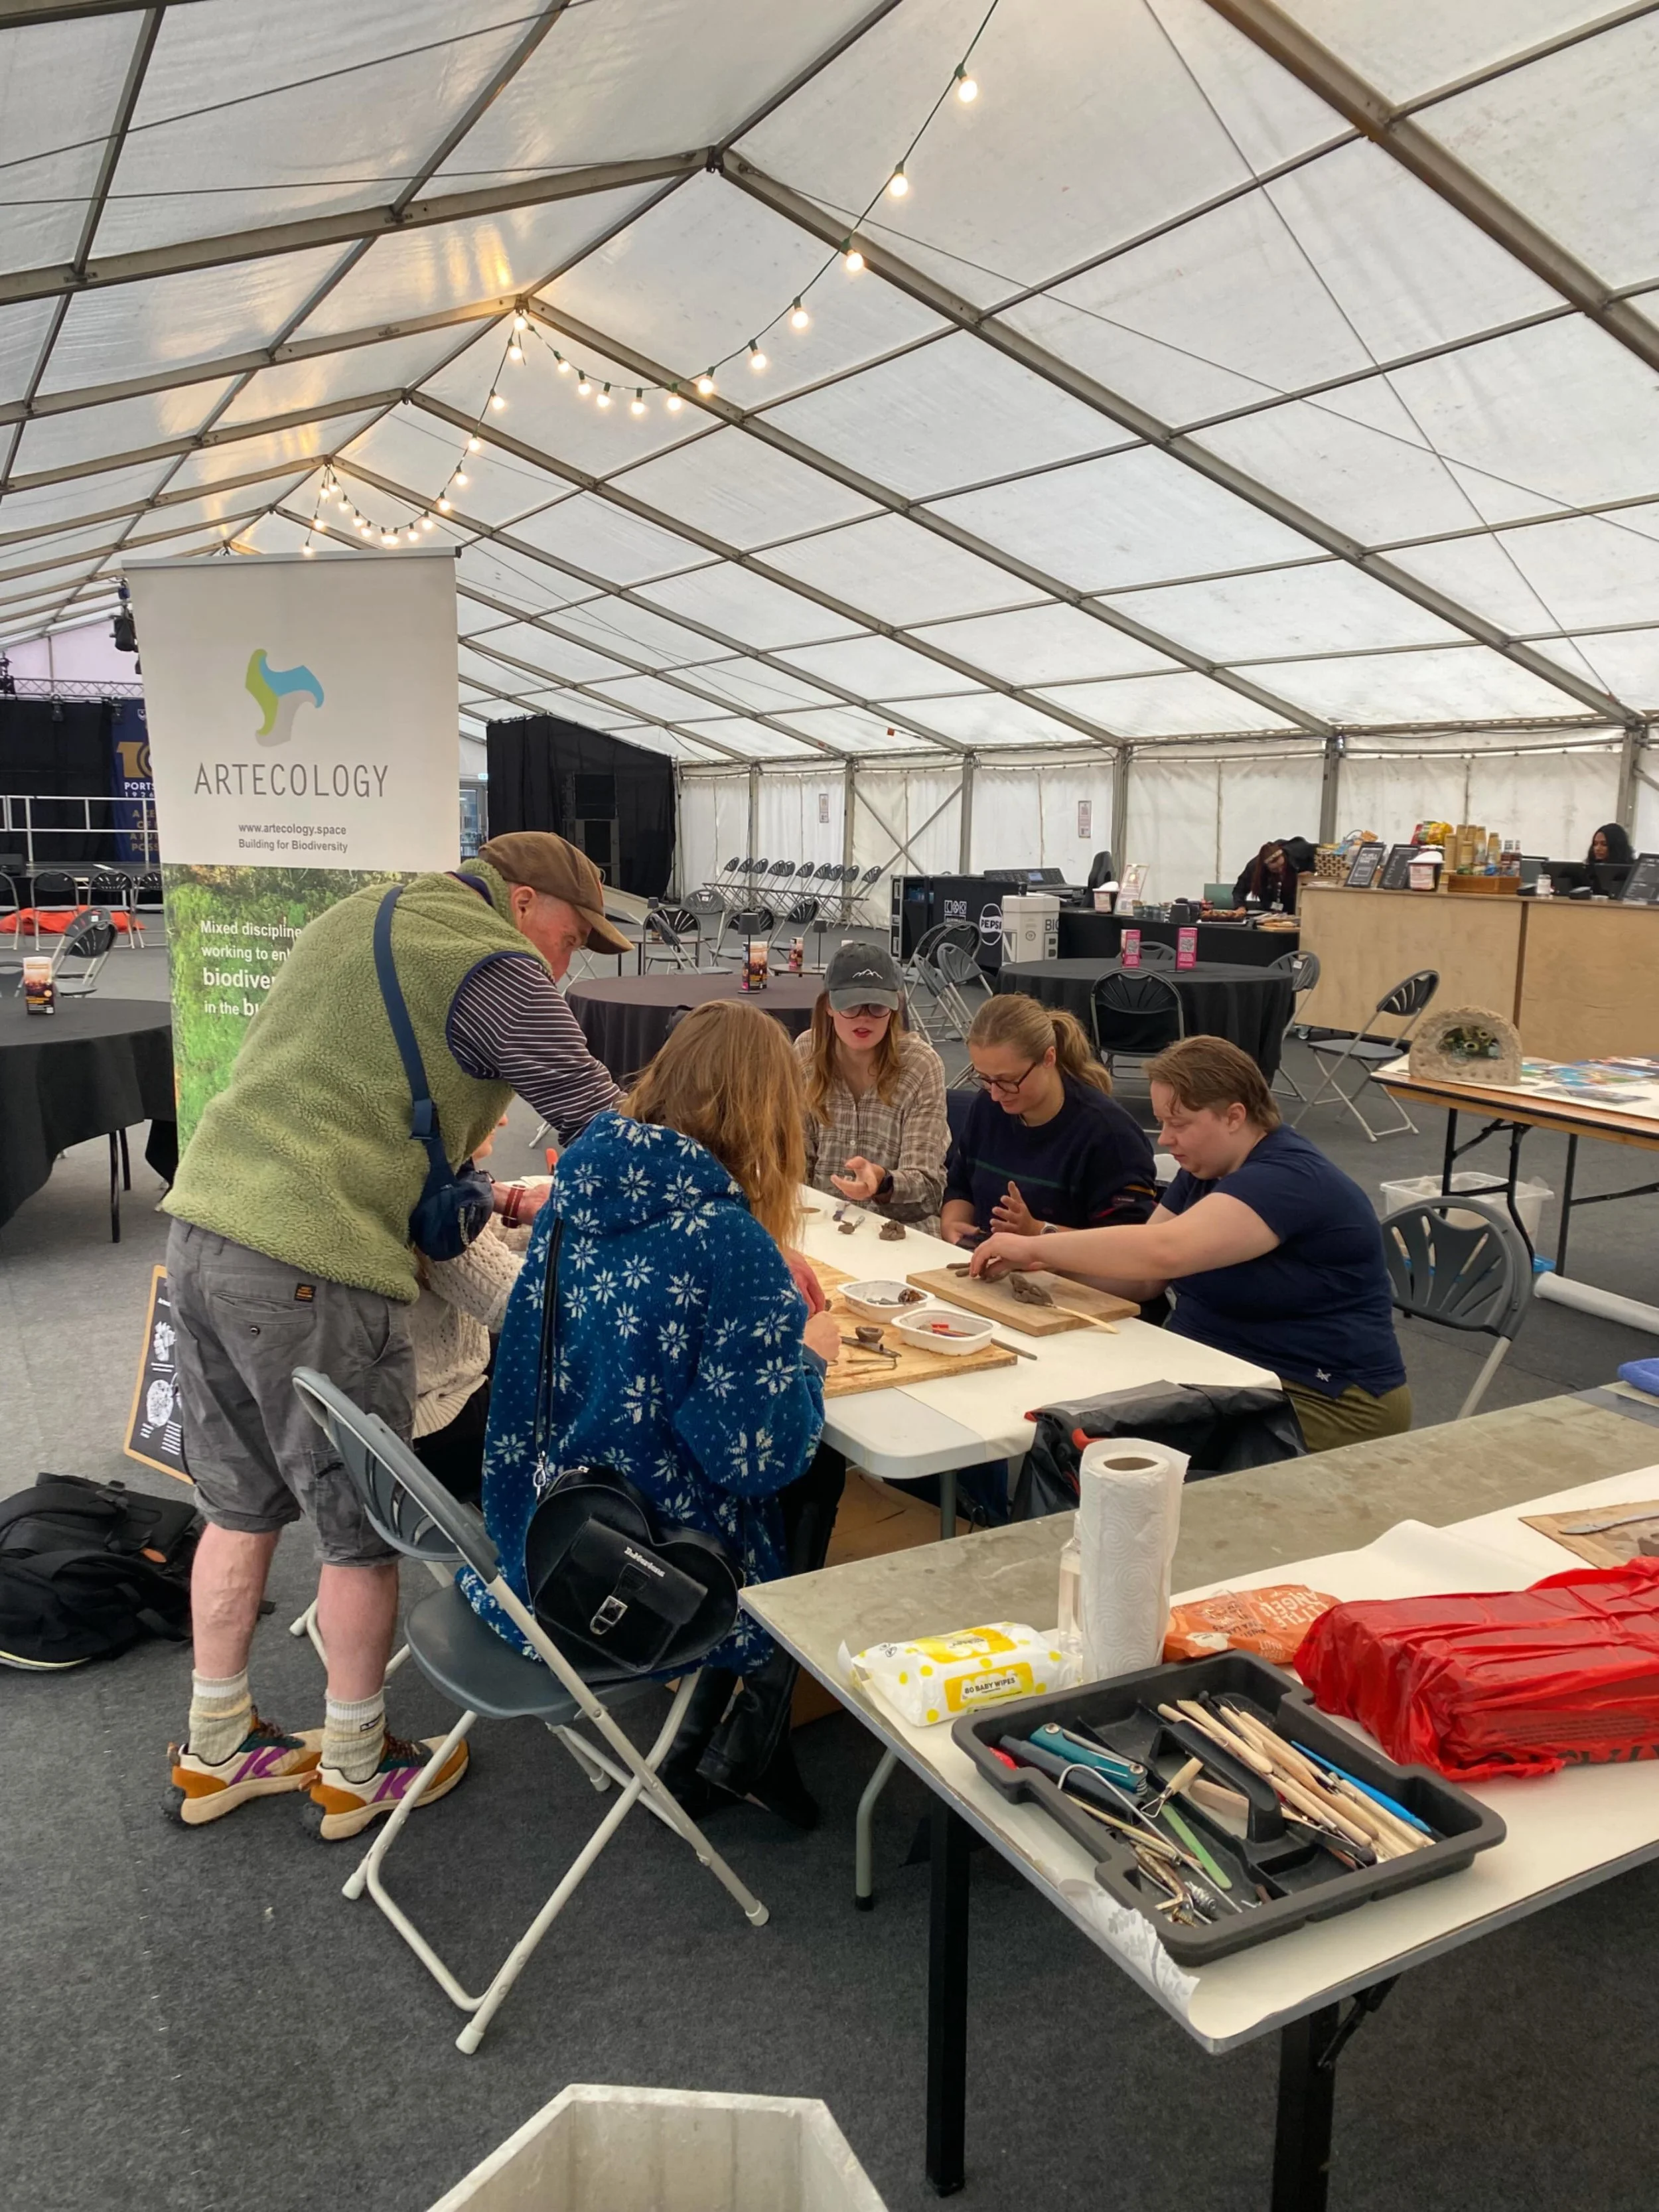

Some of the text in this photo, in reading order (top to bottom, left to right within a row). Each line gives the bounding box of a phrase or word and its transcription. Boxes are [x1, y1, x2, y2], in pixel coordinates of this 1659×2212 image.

[194, 763, 388, 798] ARTECOLOGY
[238, 824, 346, 836] www.artecology.space
[238, 839, 348, 853] Building for Biodiversity
[200, 920, 238, 934] Mixed
[981, 919, 1001, 930] PEPSI
[201, 945, 253, 962] working
[255, 947, 268, 960] to
[204, 1000, 216, 1013] in
[220, 1001, 239, 1015] the
[975, 1682, 993, 1692] BABY
[994, 1677, 1016, 1687] WIPES
